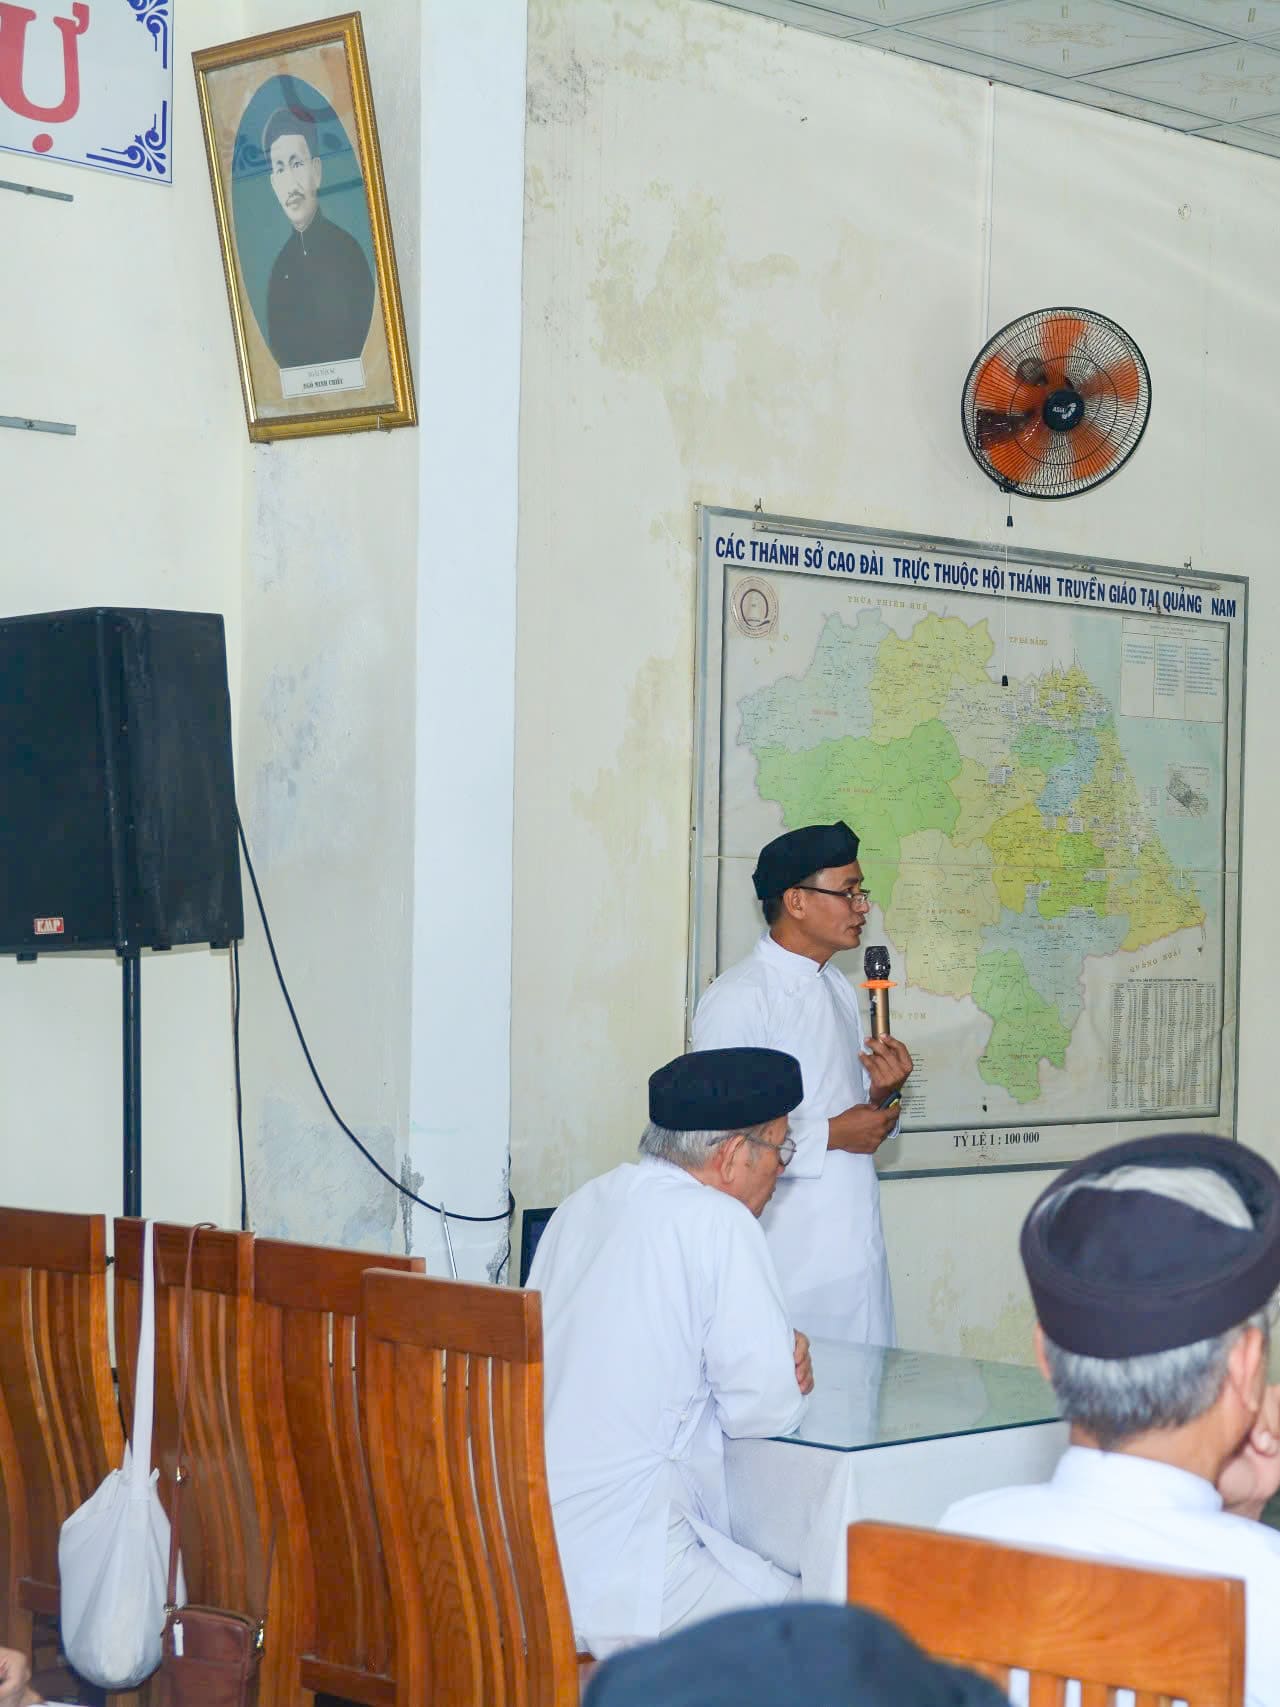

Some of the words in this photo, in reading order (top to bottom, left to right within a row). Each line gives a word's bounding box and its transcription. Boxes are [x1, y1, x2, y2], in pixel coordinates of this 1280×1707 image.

[716, 533, 745, 560] CÁC
[750, 537, 799, 566] THÁNH
[804, 541, 823, 569] SỞ
[828, 550, 855, 573] CAO
[860, 550, 884, 576] ĐÀI
[893, 557, 930, 584] TRỰC
[934, 561, 978, 587] THUỘC
[982, 566, 1005, 596] HỘI
[1009, 569, 1051, 595] THÁNH
[1057, 577, 1105, 603] TRUYỀN
[1109, 580, 1137, 606] GIÁO
[1141, 587, 1159, 611] TẠI
[1163, 586, 1202, 613] QUẢNG
[1211, 597, 1236, 617] NAM
[990, 1134, 995, 1146] 1
[1005, 1132, 1021, 1145] 100
[1023, 1131, 1040, 1144] 000
